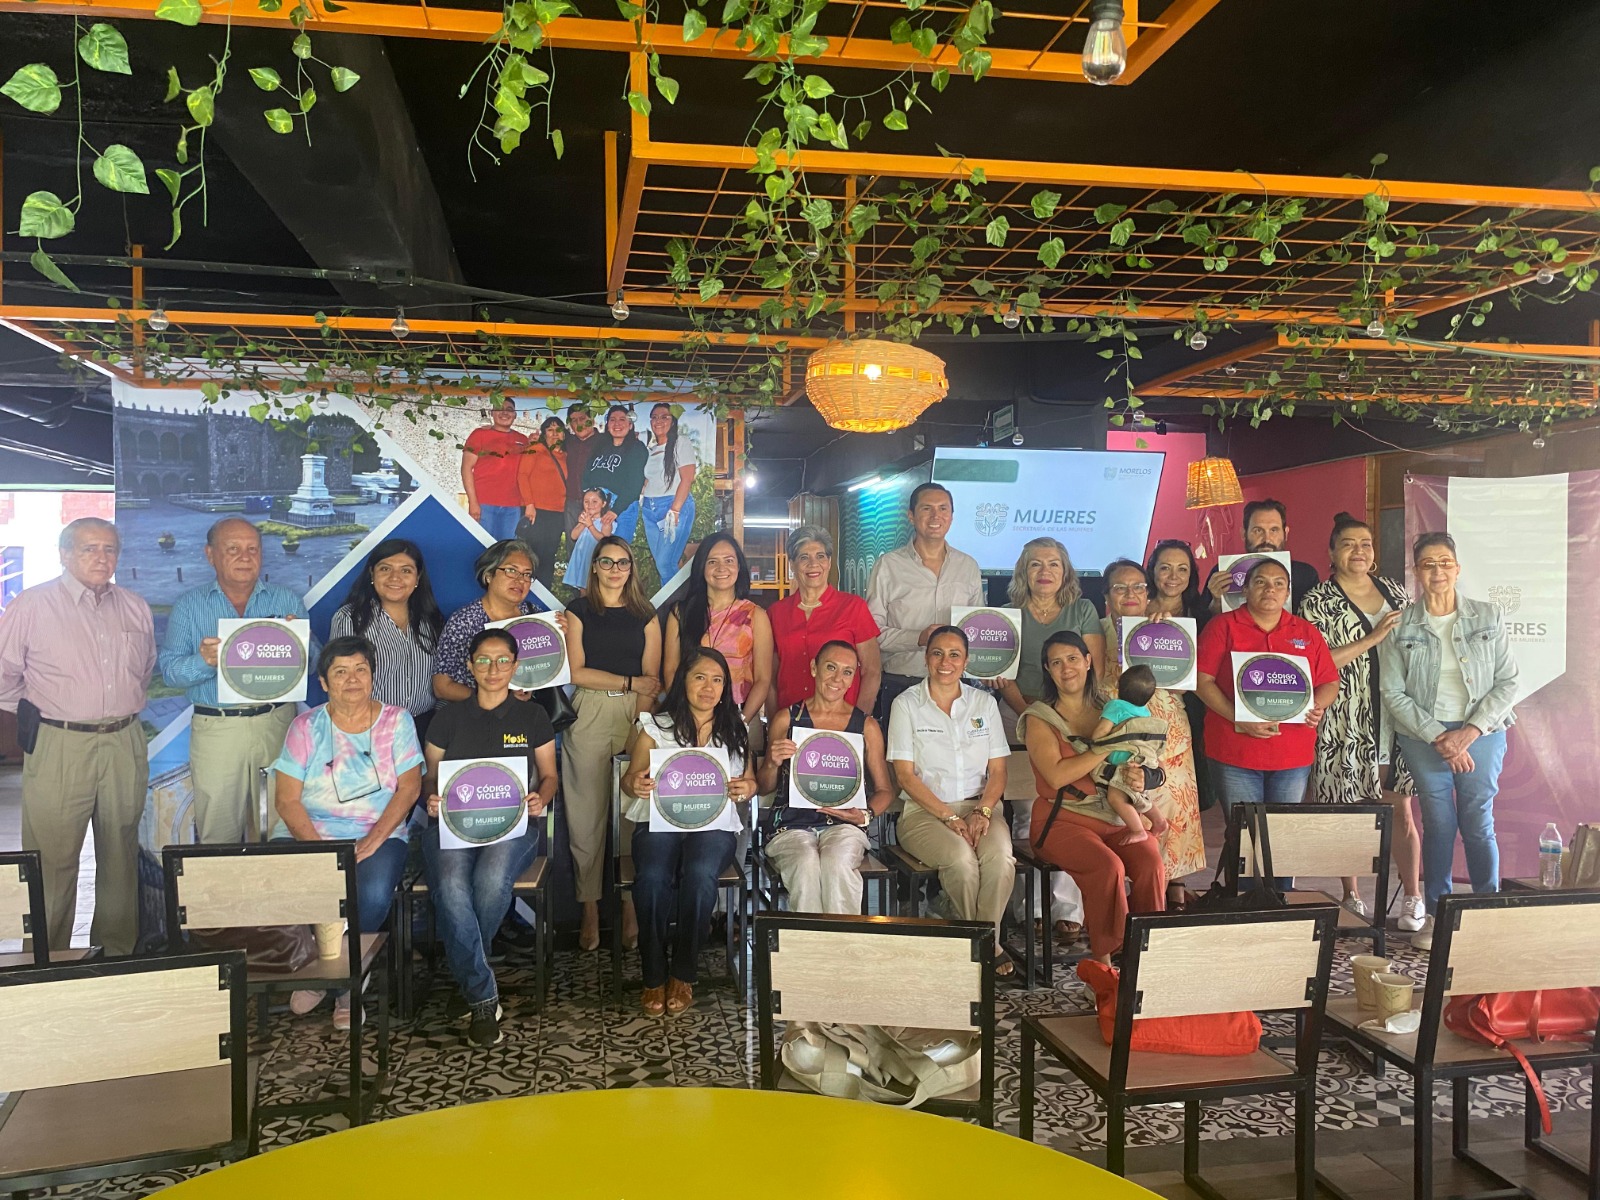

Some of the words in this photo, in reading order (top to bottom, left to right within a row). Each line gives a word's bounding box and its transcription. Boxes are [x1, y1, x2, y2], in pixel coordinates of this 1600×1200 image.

[1014, 509, 1096, 525] MUJERES
[980, 628, 1008, 636] CÓDIGO
[1505, 622, 1547, 636] ERES
[521, 635, 551, 645] CÓDIGO
[1153, 636, 1183, 646] CÓDIGO
[257, 643, 292, 652] CÓDIGO
[522, 641, 552, 651] VIOLETA
[1154, 644, 1183, 652] VIOLETA
[257, 651, 292, 659] VIOLETA
[1266, 671, 1297, 680] CÓDIGO
[503, 733, 528, 744] Moshi
[821, 752, 850, 763] CÓDIGO
[821, 761, 850, 769] VIOLETA
[685, 771, 716, 780] CÓDIGO
[685, 779, 717, 787] VIOLETA
[476, 784, 511, 793] CÓDIGO
[476, 791, 512, 800] VIOLETA
[475, 816, 506, 824] MUJERES
